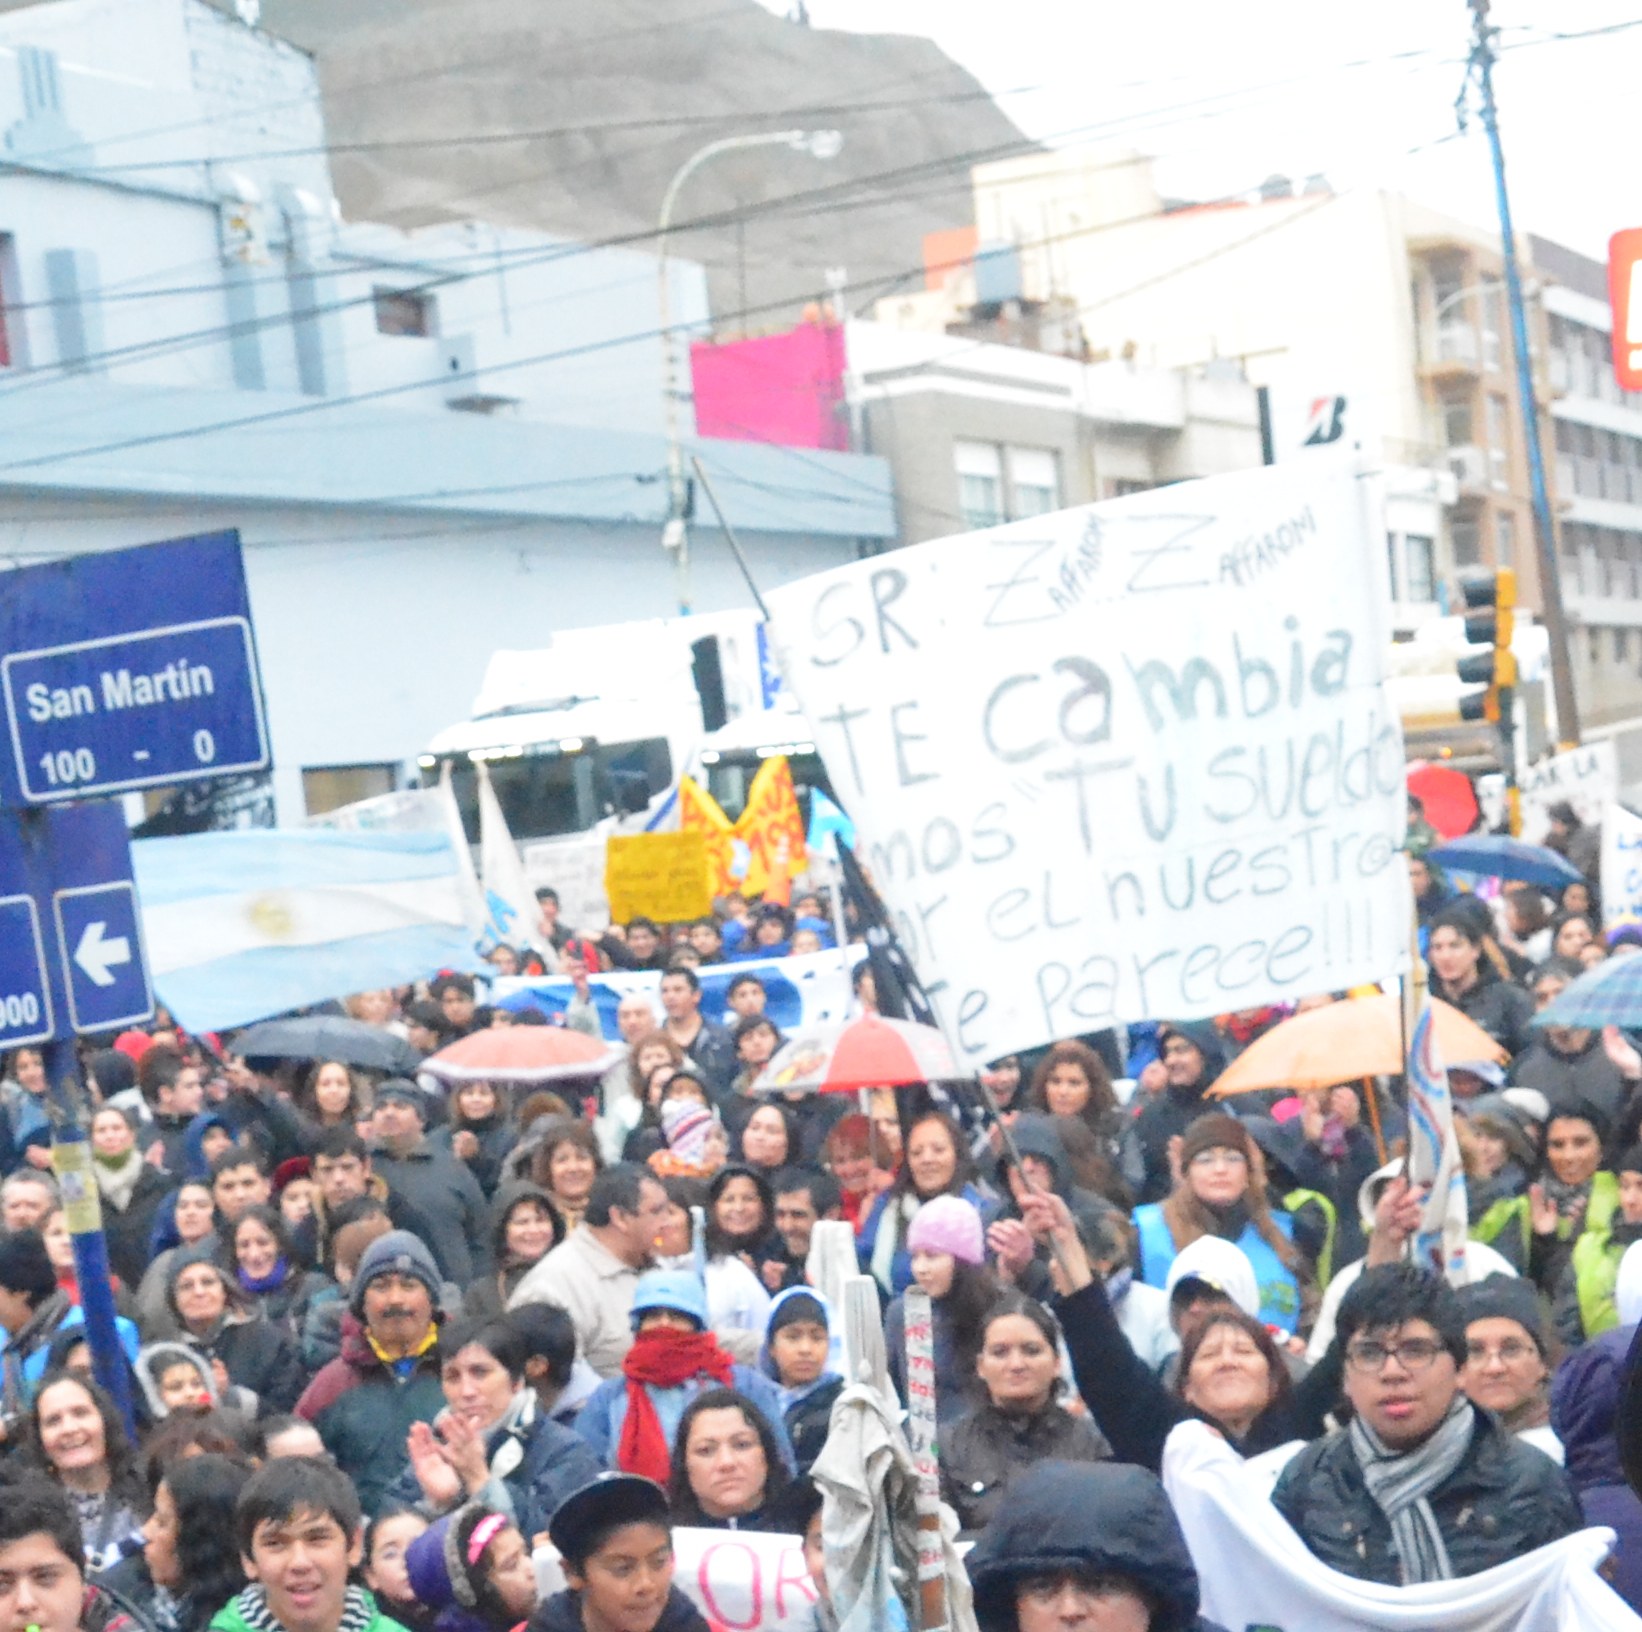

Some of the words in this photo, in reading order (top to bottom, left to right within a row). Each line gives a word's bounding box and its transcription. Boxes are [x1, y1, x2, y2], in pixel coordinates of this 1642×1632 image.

[26, 680, 95, 724] San
[102, 657, 214, 713] Martín
[40, 748, 96, 786] 100
[193, 728, 215, 764] 0
